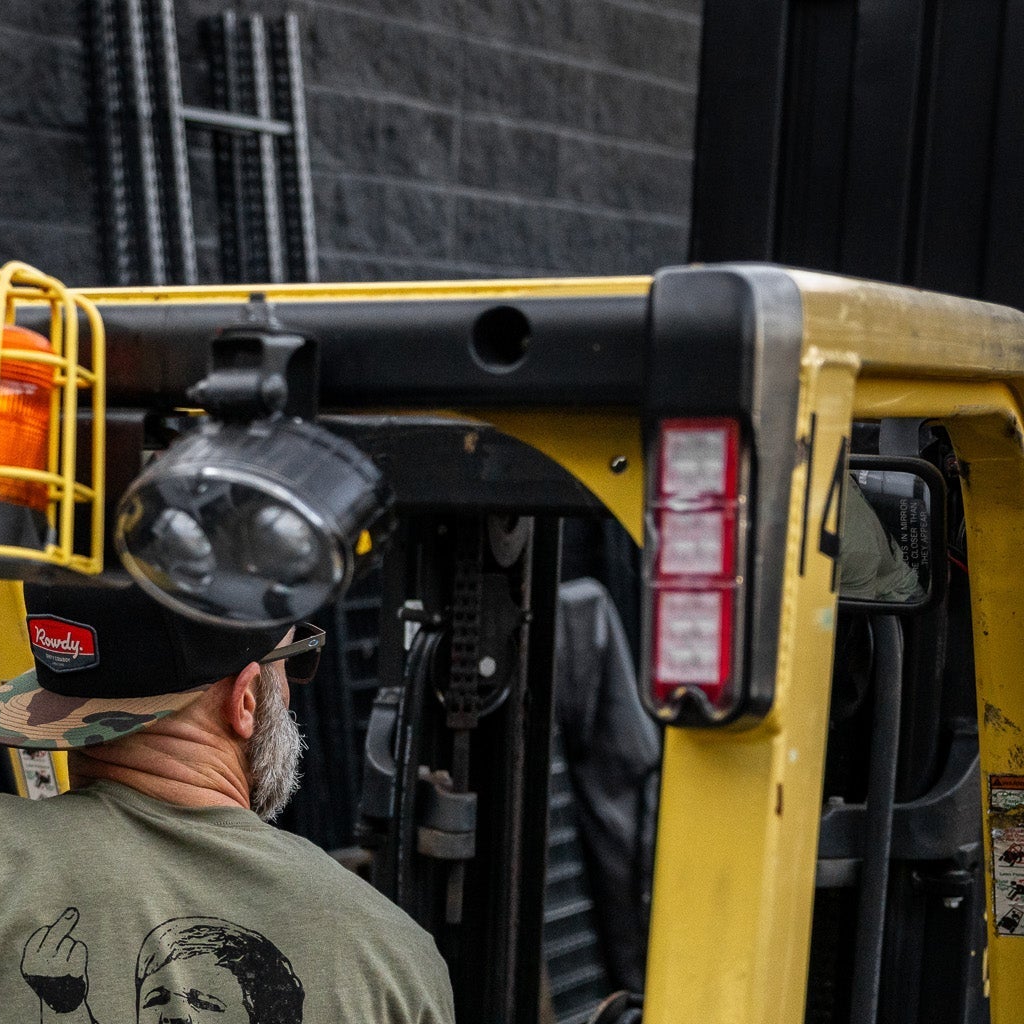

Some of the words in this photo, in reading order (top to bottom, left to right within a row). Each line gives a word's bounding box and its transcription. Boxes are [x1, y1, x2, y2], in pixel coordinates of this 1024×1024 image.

[899, 499, 909, 531] MIRROR
[909, 502, 918, 524] THAN
[919, 511, 929, 544] APPEAR
[910, 527, 919, 559] CLOSER
[920, 544, 929, 566] THEY
[34, 625, 83, 659] Rowdy.
